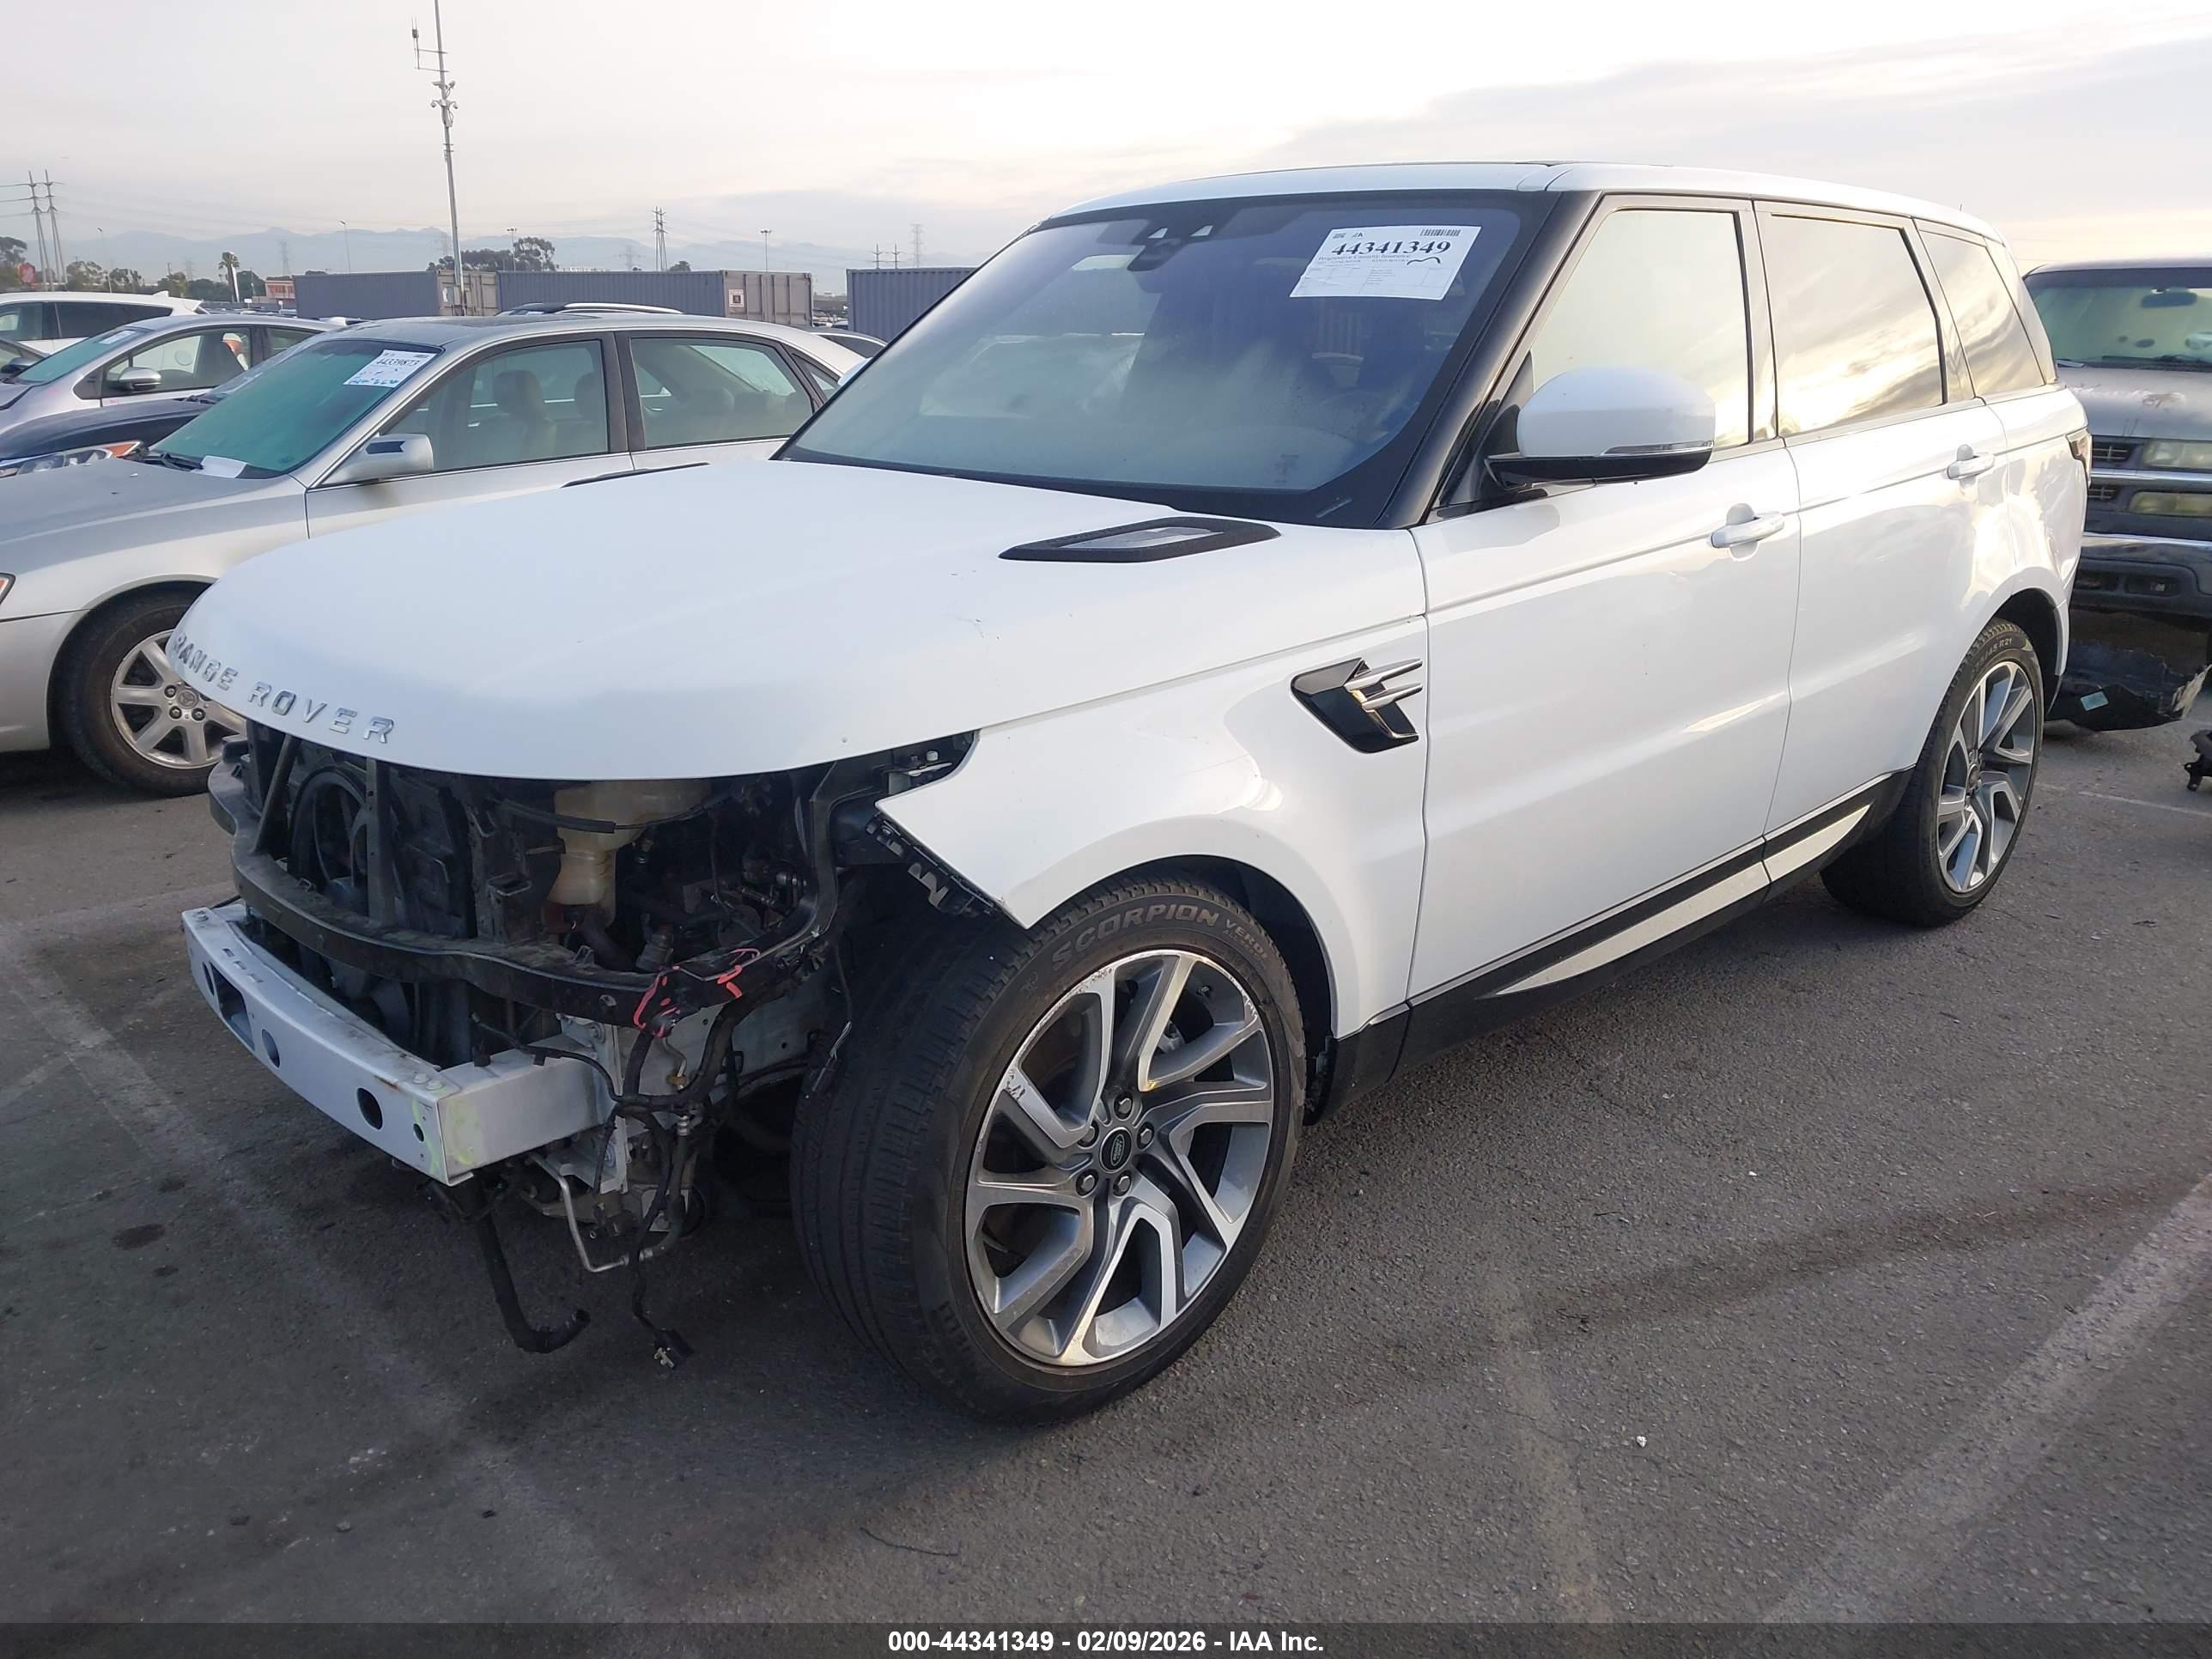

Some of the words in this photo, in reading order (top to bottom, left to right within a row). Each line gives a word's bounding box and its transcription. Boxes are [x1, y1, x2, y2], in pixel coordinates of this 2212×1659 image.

[1332, 240, 1451, 255] 44341349
[172, 632, 239, 690] RANGE
[247, 680, 395, 744] ROVER
[1051, 903, 1220, 970] SCORPION
